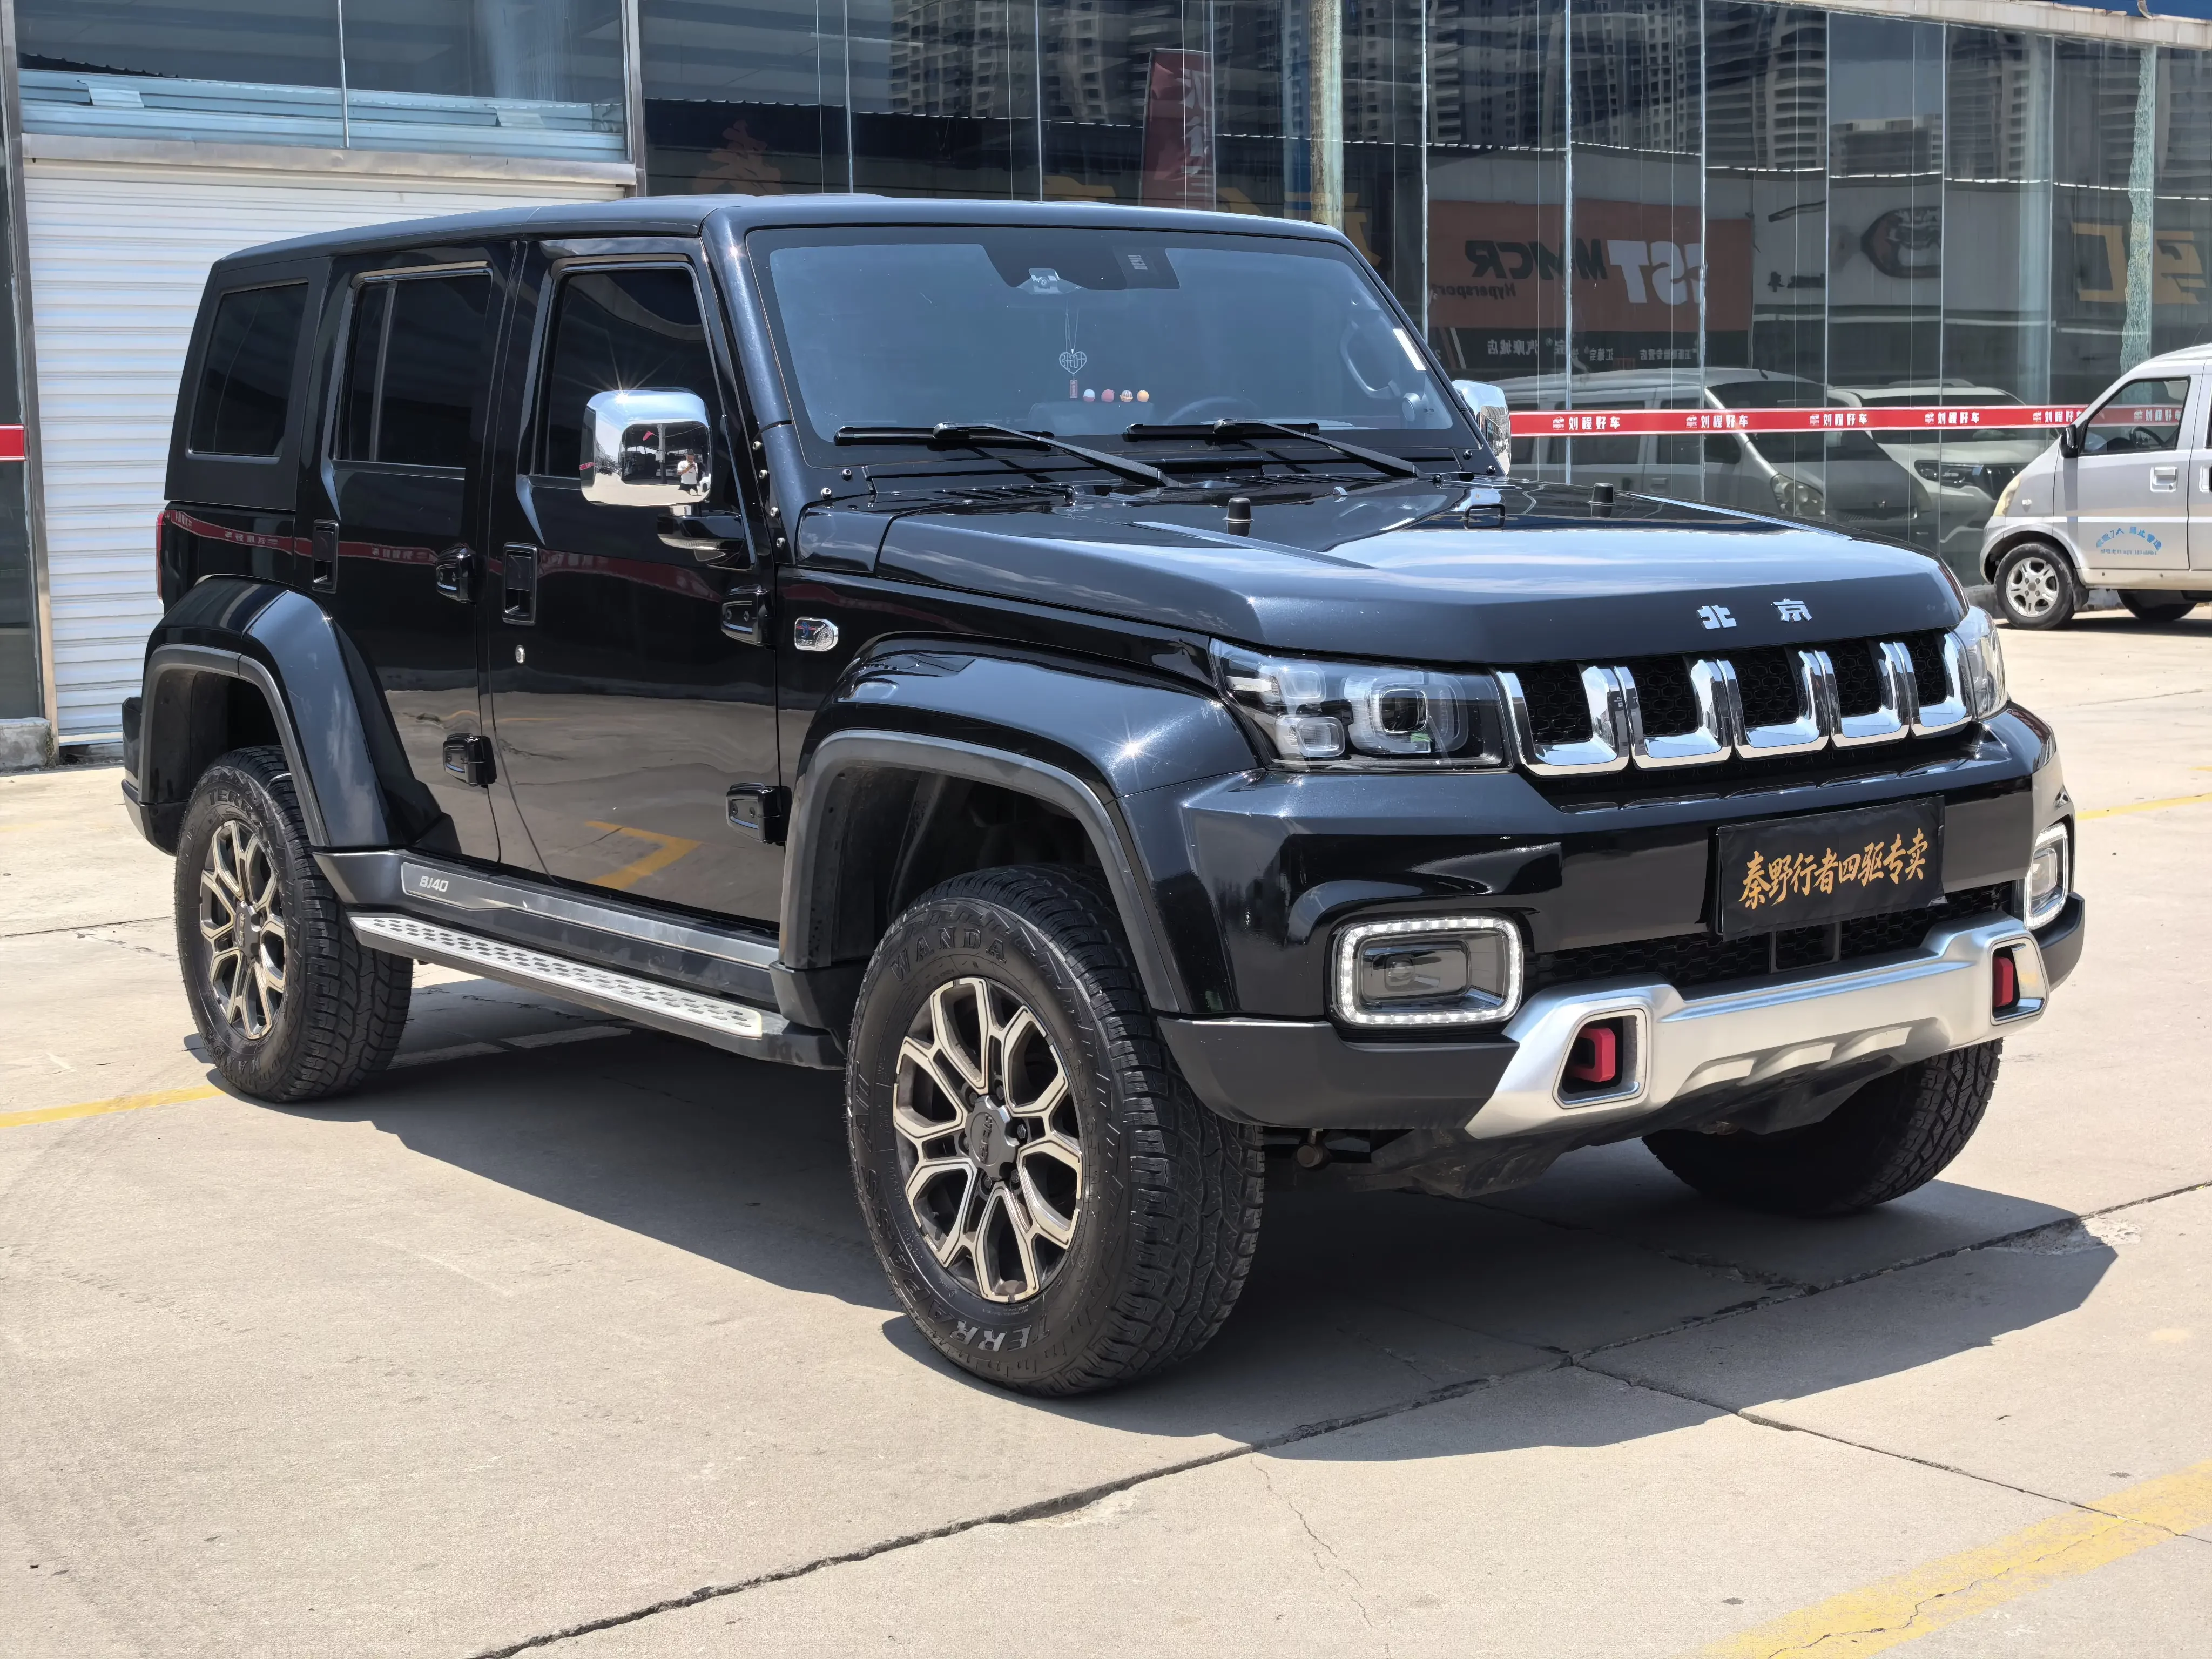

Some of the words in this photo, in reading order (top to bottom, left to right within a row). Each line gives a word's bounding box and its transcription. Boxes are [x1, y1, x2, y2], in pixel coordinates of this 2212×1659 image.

[1696, 598, 1812, 630] 北京
[419, 875, 449, 892] BJ40
[1738, 828, 1928, 909] 秦野行者四驱专卖
[889, 926, 1007, 981] WANDA
